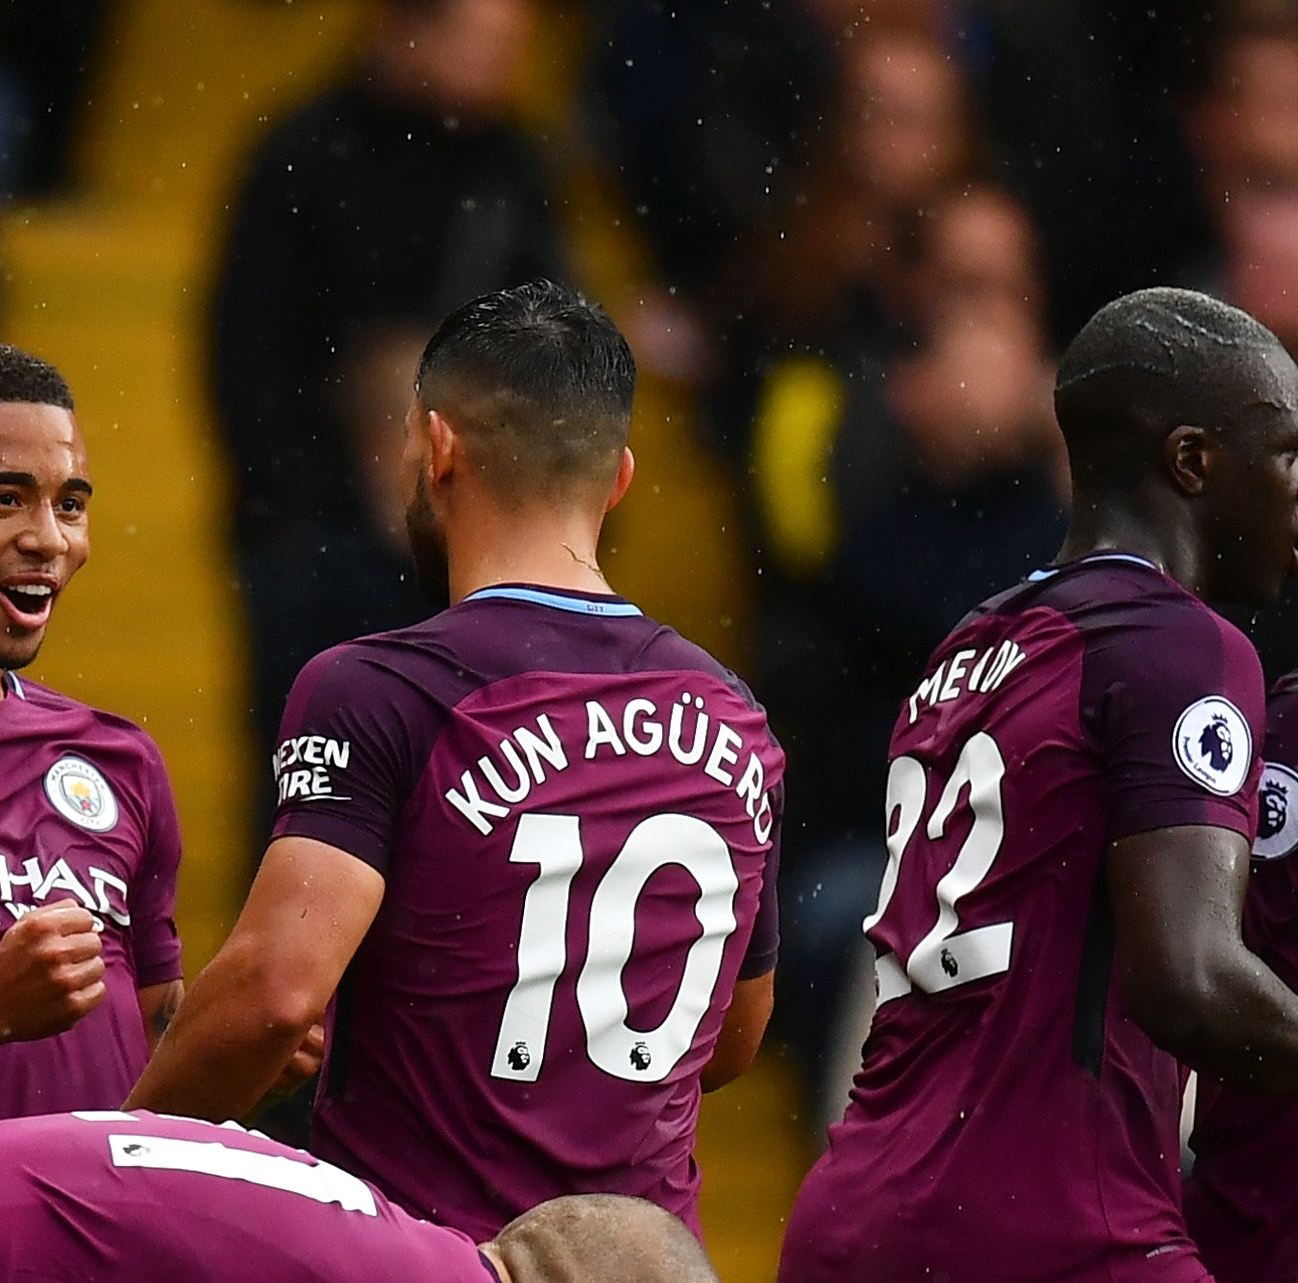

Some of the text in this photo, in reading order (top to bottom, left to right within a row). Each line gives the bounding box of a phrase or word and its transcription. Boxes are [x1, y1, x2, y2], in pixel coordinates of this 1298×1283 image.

[445, 692, 774, 845] KUN AGÜERO
[490, 812, 740, 1083] 10
